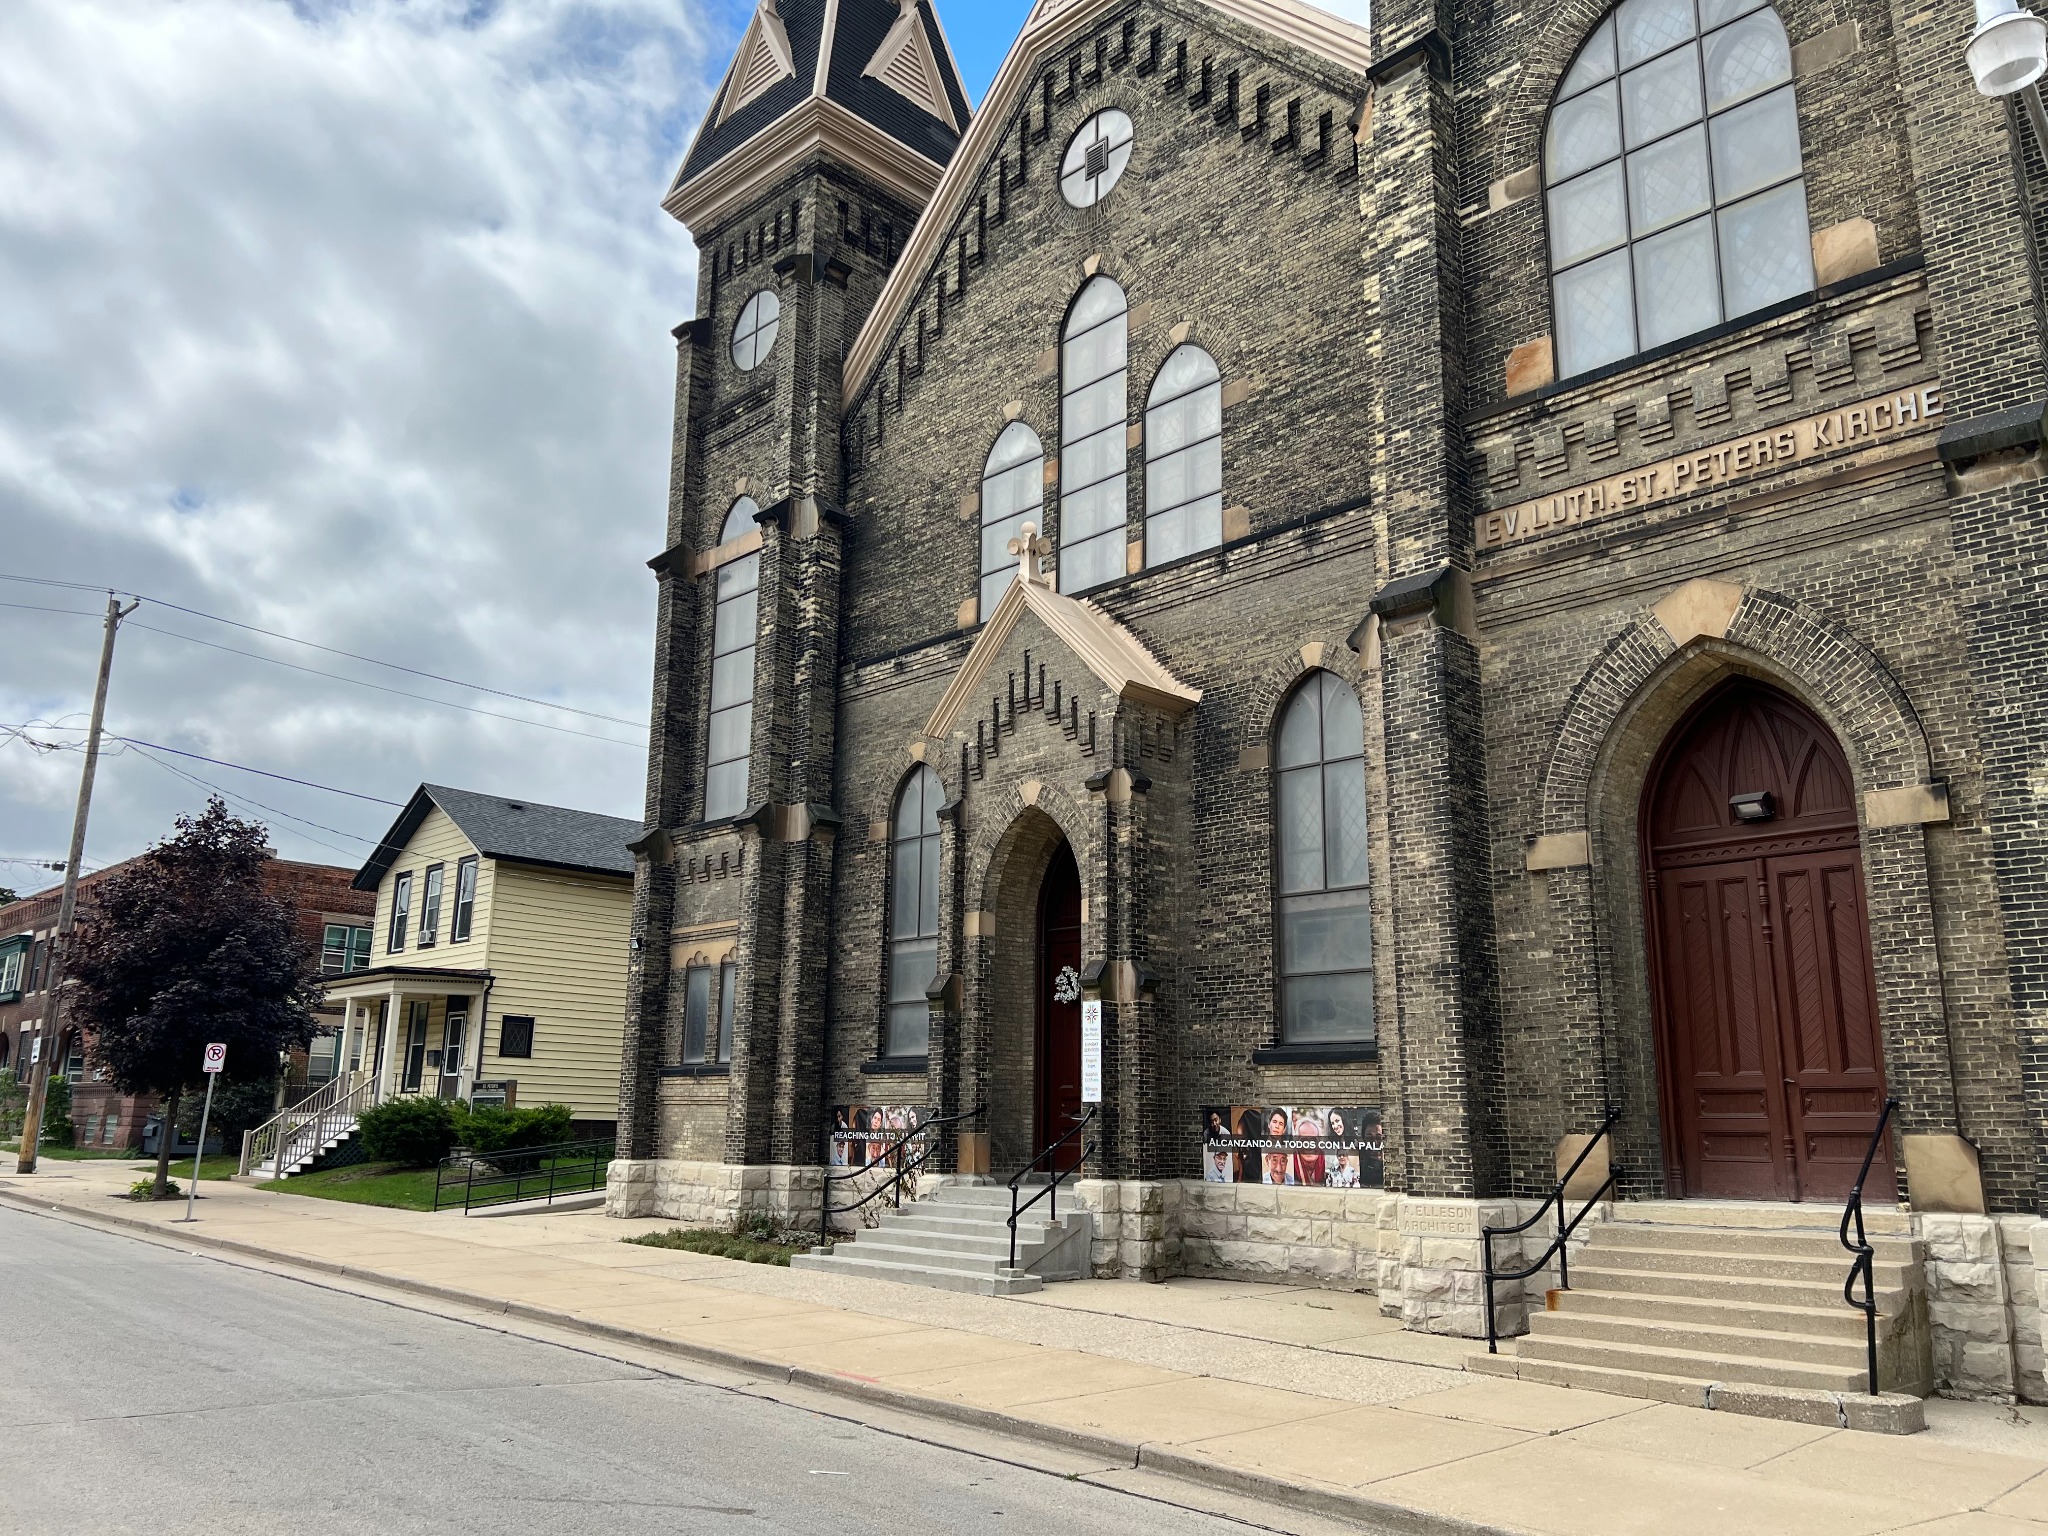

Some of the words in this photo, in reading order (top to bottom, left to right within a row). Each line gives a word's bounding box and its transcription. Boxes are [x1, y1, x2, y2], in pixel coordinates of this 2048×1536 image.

[1673, 429, 1796, 489] PETERS
[1810, 385, 1944, 450] KIRCHE
[834, 1131, 868, 1140] REACHING
[870, 1132, 883, 1140] OUT
[885, 1132, 896, 1141] TO
[1208, 1137, 1273, 1148] ALCANZANDO
[1274, 1140, 1282, 1148] A
[1284, 1140, 1316, 1149] TODOS
[1317, 1141, 1340, 1150] CON
[1342, 1141, 1356, 1150] LA
[1403, 1220, 1473, 1233] ARCHITECT
